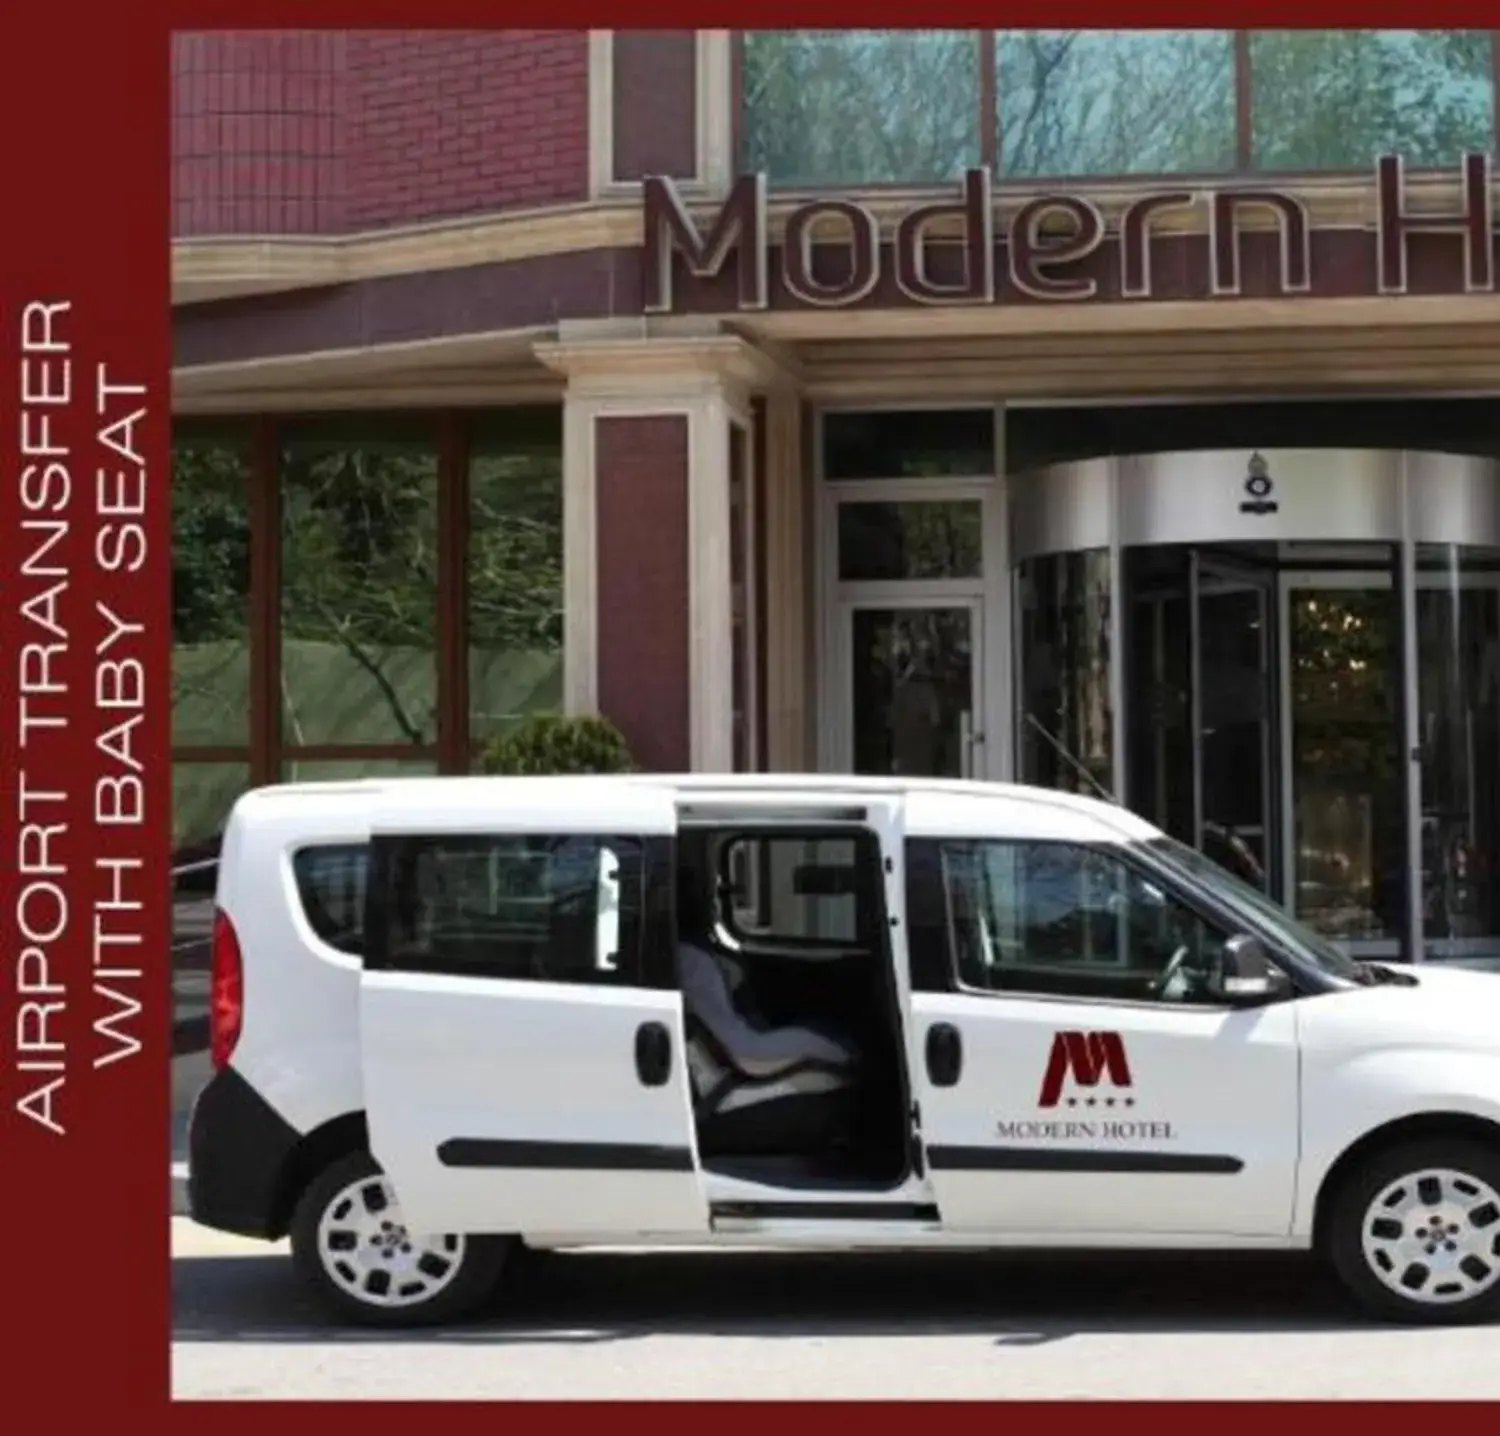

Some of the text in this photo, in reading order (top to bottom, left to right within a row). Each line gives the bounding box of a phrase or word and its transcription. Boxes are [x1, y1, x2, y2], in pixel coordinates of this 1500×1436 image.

[642, 165, 1312, 314] Modern
[995, 1120, 1178, 1140] MODERN HOTEL
